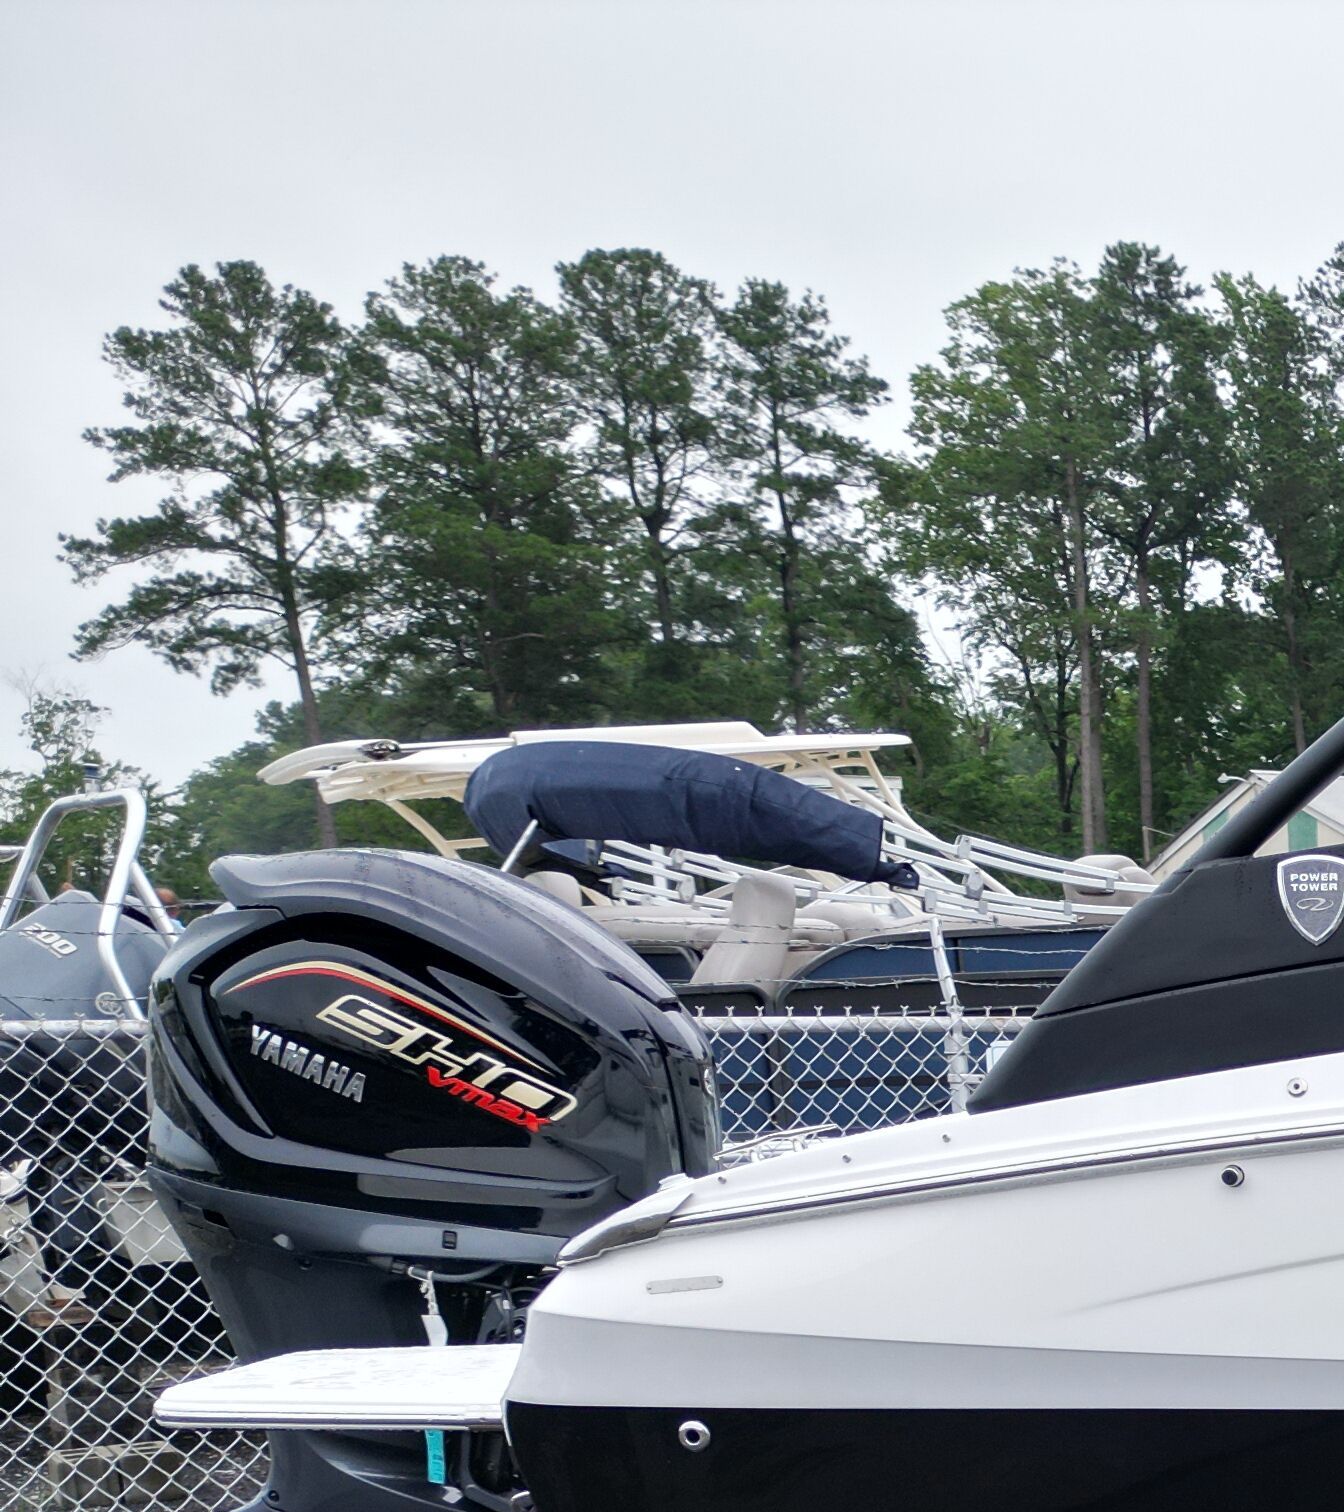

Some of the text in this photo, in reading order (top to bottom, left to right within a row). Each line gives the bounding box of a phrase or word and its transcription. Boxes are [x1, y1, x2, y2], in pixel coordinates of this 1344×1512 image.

[1290, 873, 1338, 881] POWER
[1290, 883, 1338, 891] TOWER
[251, 1024, 367, 1103] YAMAHA
[316, 994, 578, 1121] SHO
